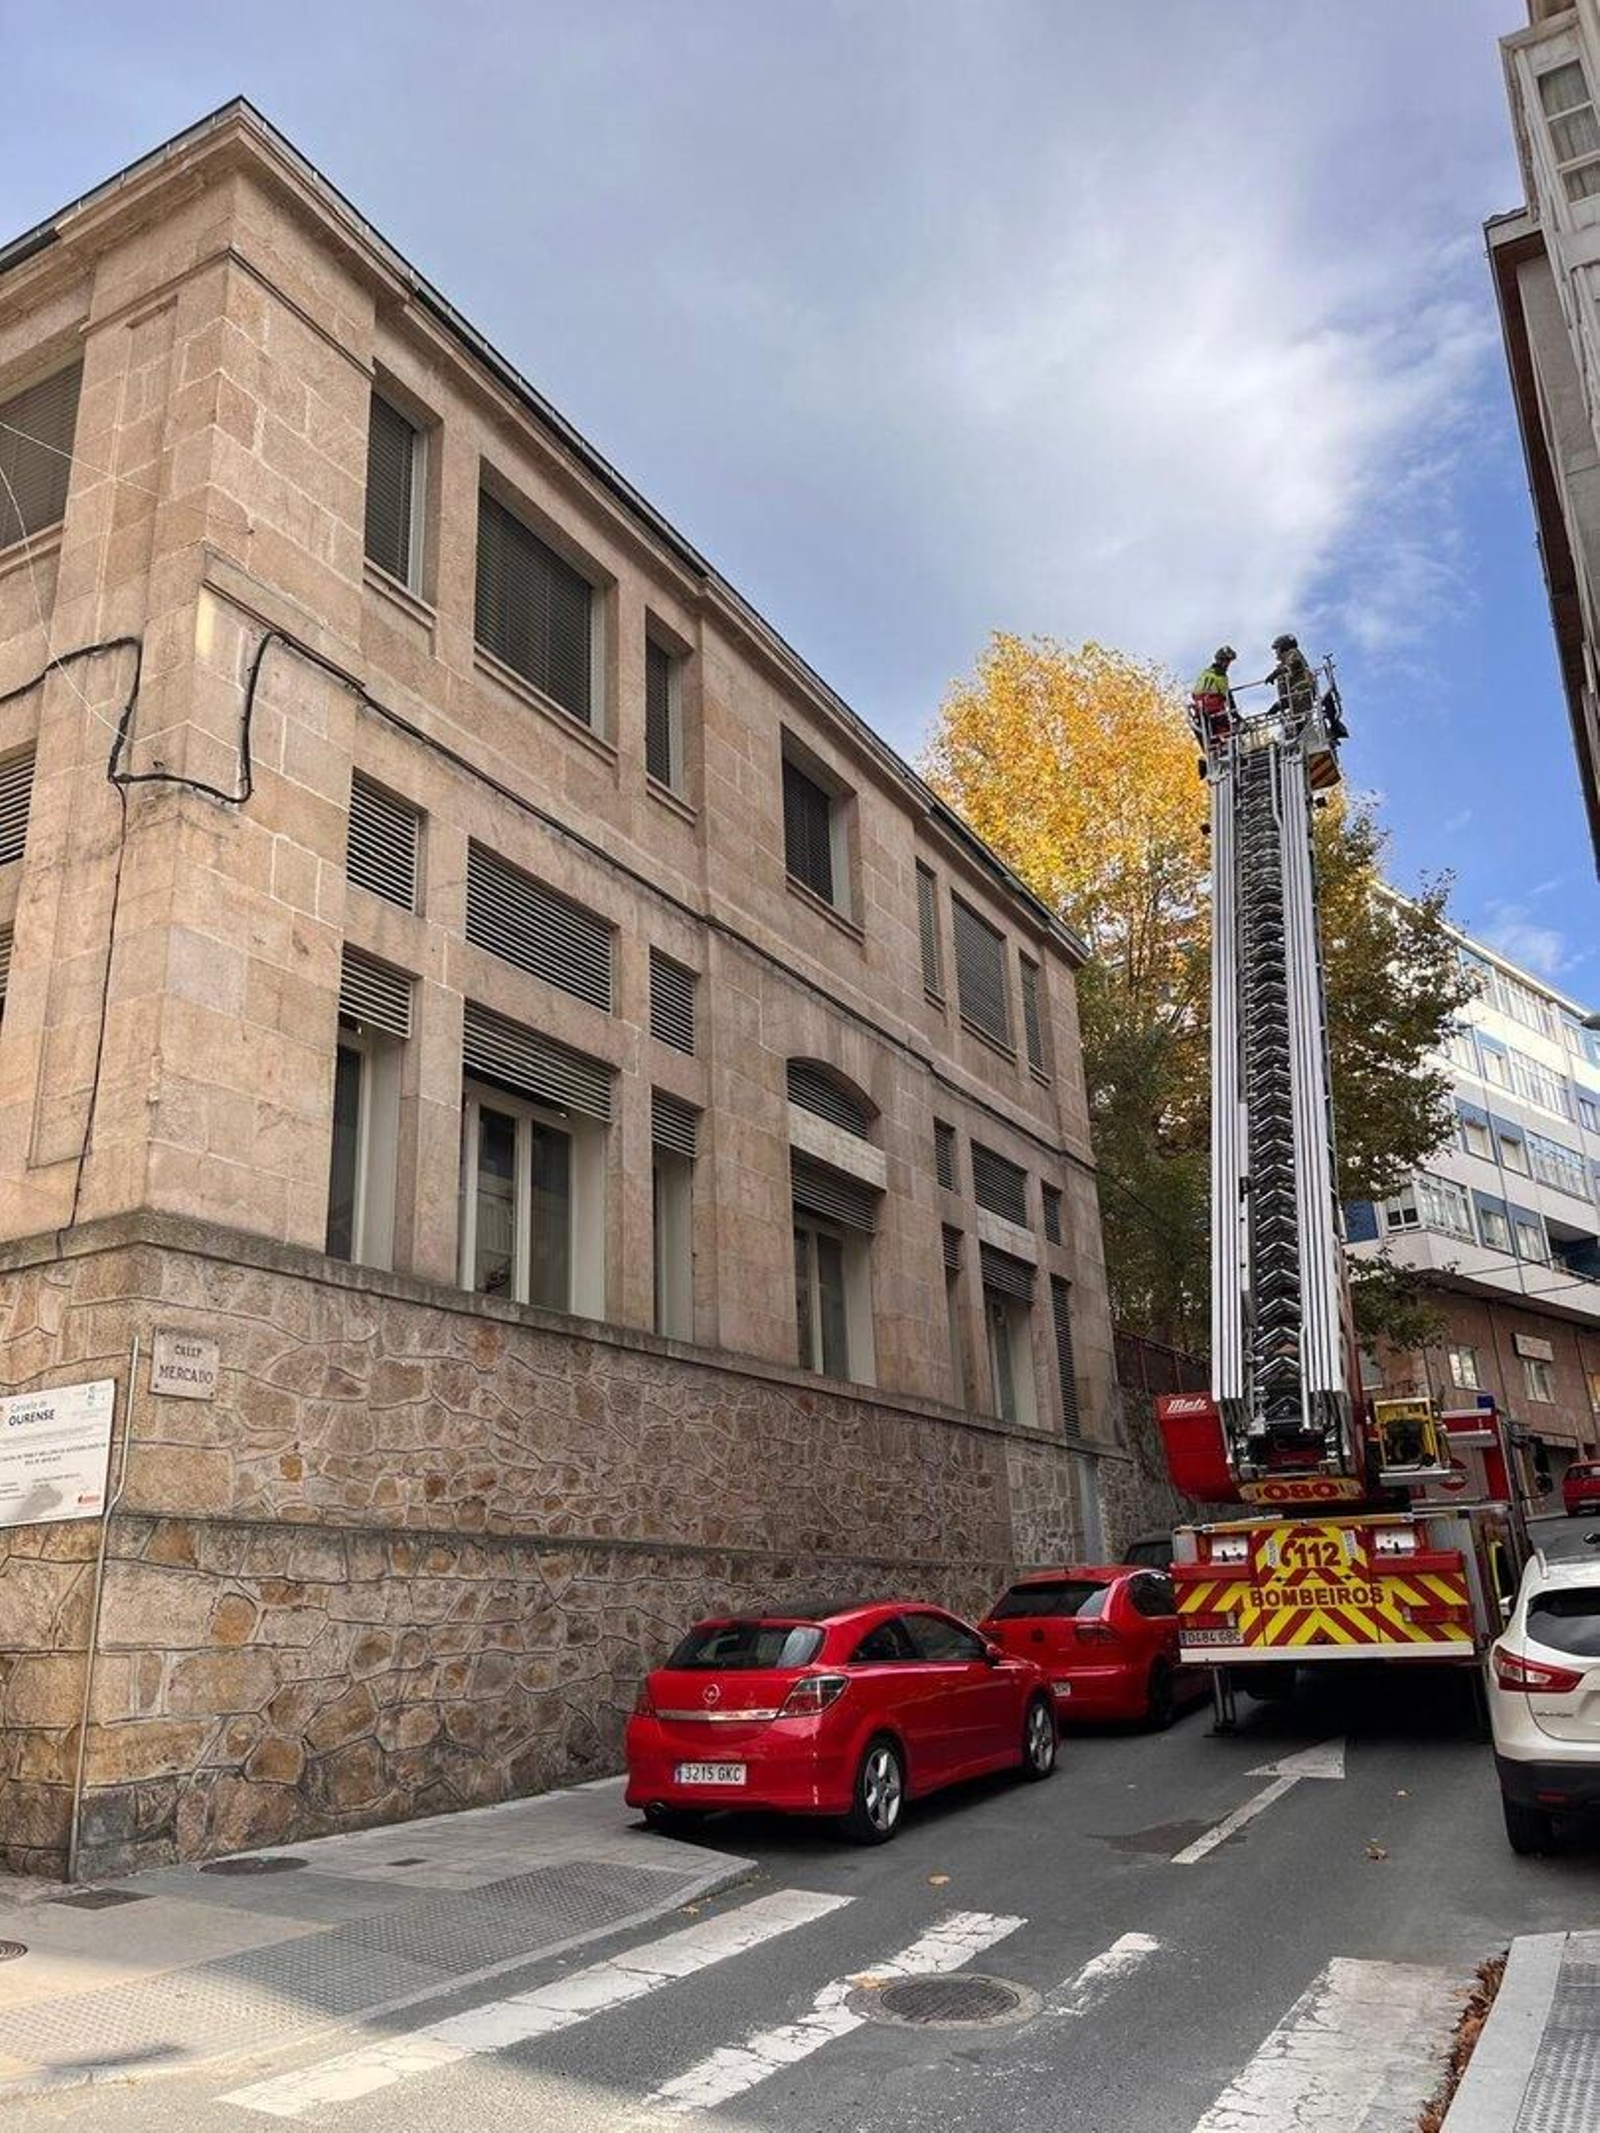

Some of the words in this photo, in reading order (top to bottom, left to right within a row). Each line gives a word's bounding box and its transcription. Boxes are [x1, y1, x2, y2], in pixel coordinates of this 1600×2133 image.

[159, 1365, 214, 1385] MERCADO
[9, 1409, 55, 1426] OURENSE
[1263, 1482, 1339, 1500] 080
[1294, 1541, 1341, 1567] 112
[1250, 1586, 1384, 1607] BOMBEIROS
[685, 1766, 714, 1780] 3215
[718, 1766, 741, 1781] GKC
